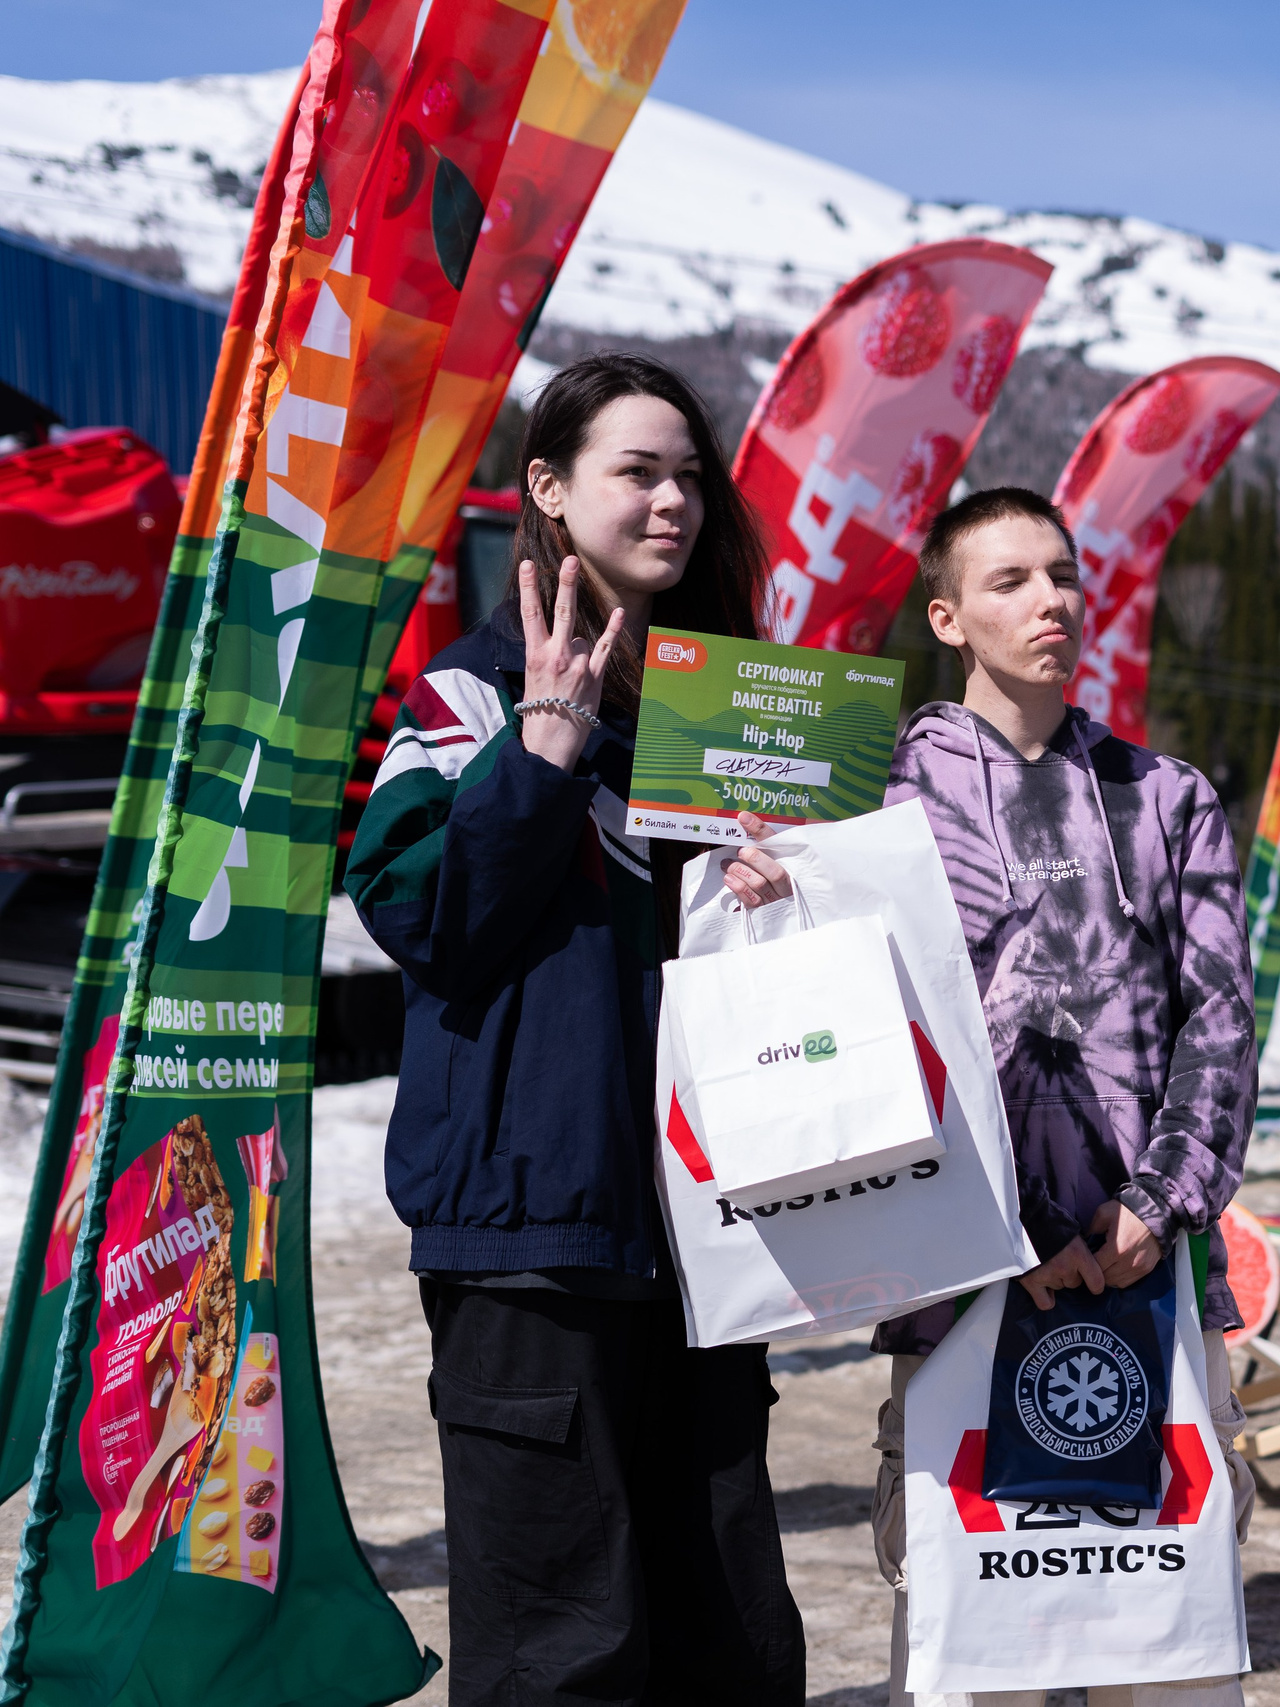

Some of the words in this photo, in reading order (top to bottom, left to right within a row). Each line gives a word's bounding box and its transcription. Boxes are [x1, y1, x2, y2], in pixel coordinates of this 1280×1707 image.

[661, 652, 674, 660] FEST
[737, 661, 825, 688] СЕРТИФИКАТ
[845, 669, 896, 688] фрутилад
[751, 682, 777, 692] вручается
[776, 685, 808, 696] победителю
[731, 690, 775, 712] DANCE
[776, 695, 823, 718] BATTLE
[764, 714, 793, 723] номинации
[742, 724, 805, 754] Hip-Hop
[722, 782, 732, 799] 5
[733, 784, 761, 802] 000
[762, 789, 811, 810] рублей
[644, 818, 677, 830] билайн
[1018, 867, 1089, 882] strangers.
[1029, 858, 1044, 871] all
[1045, 857, 1081, 870] start
[757, 1035, 838, 1066] drivee
[197, 1057, 280, 1090] семьи
[105, 1206, 220, 1308] фрутилад
[114, 1289, 183, 1347] гранола
[1022, 1327, 1081, 1382] ХОККЕЙНЫЙ
[1085, 1329, 1115, 1350] КЛУБ
[1114, 1346, 1142, 1390] СИБИРЬ
[99, 1411, 140, 1437] ПРОРОЩЕННАЯ
[1020, 1397, 1102, 1457] НОВОСИБИРСКАЯ
[1103, 1407, 1144, 1451] ОБЛАСТЬ
[101, 1430, 129, 1448] ПШЕНИЦА
[979, 1543, 1187, 1580] ROSTIC'S
